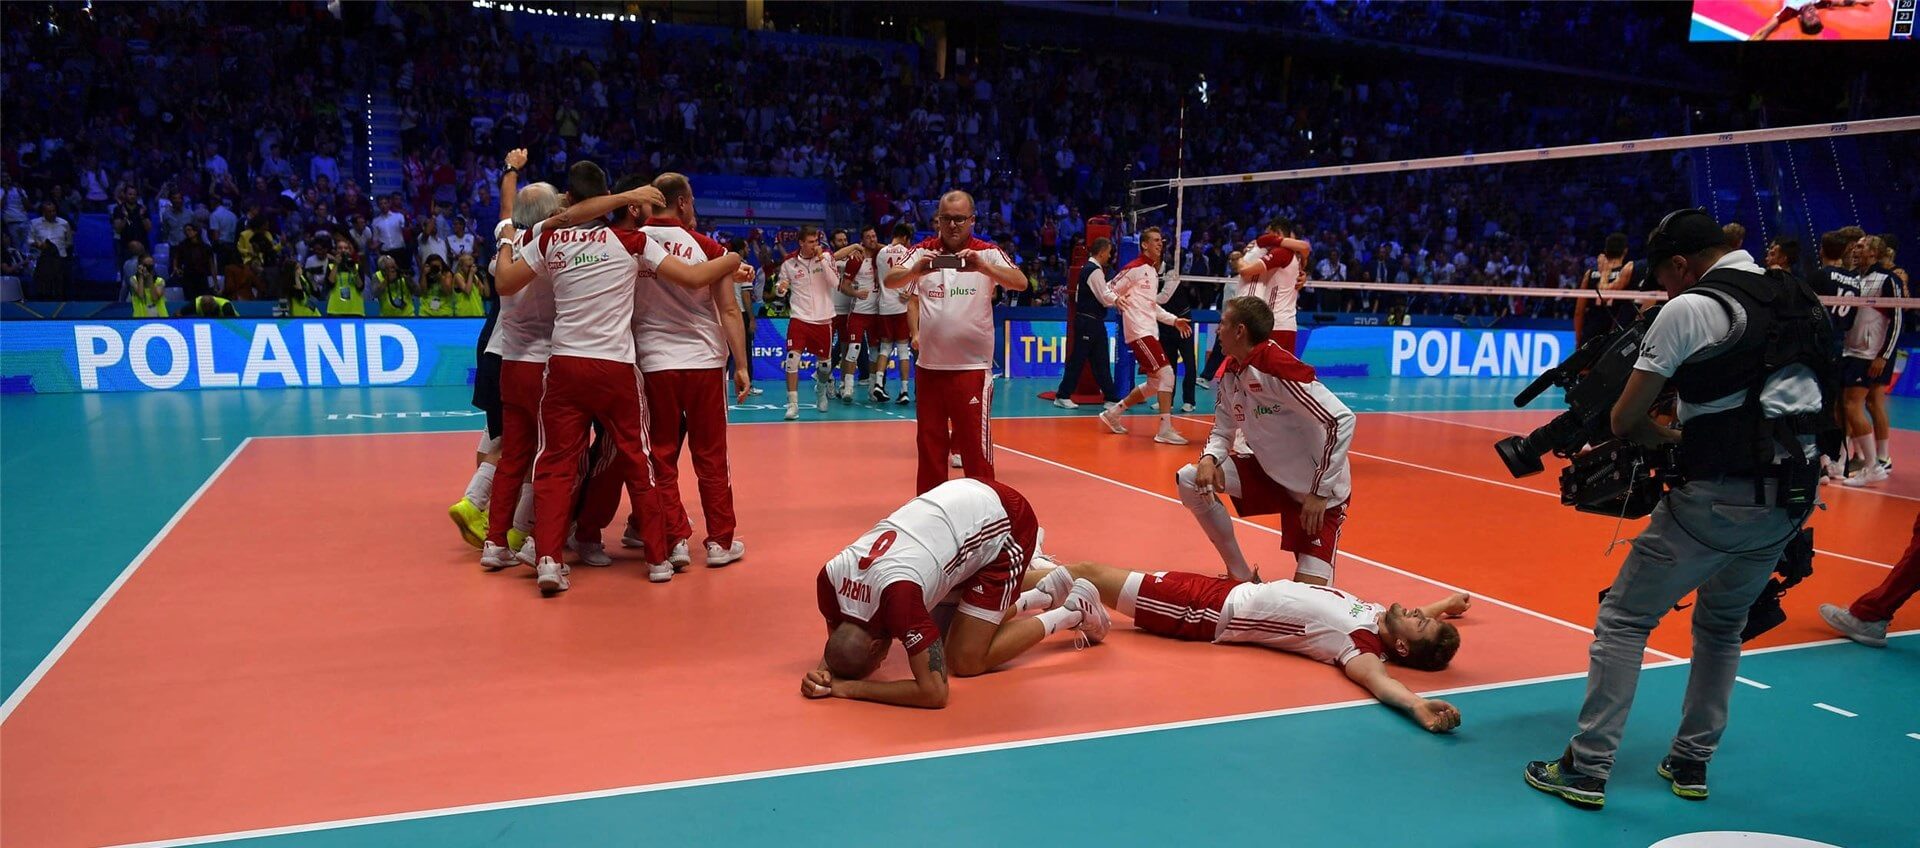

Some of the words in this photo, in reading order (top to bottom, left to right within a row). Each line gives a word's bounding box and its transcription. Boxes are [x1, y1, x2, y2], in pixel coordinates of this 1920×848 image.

[551, 230, 607, 245] POLSKA
[574, 253, 600, 266] plus
[950, 286, 969, 297] plus
[1353, 316, 1379, 326] FIVB
[74, 323, 420, 390] POLAND
[1391, 329, 1561, 377] POLAND
[838, 577, 872, 604] KUREK
